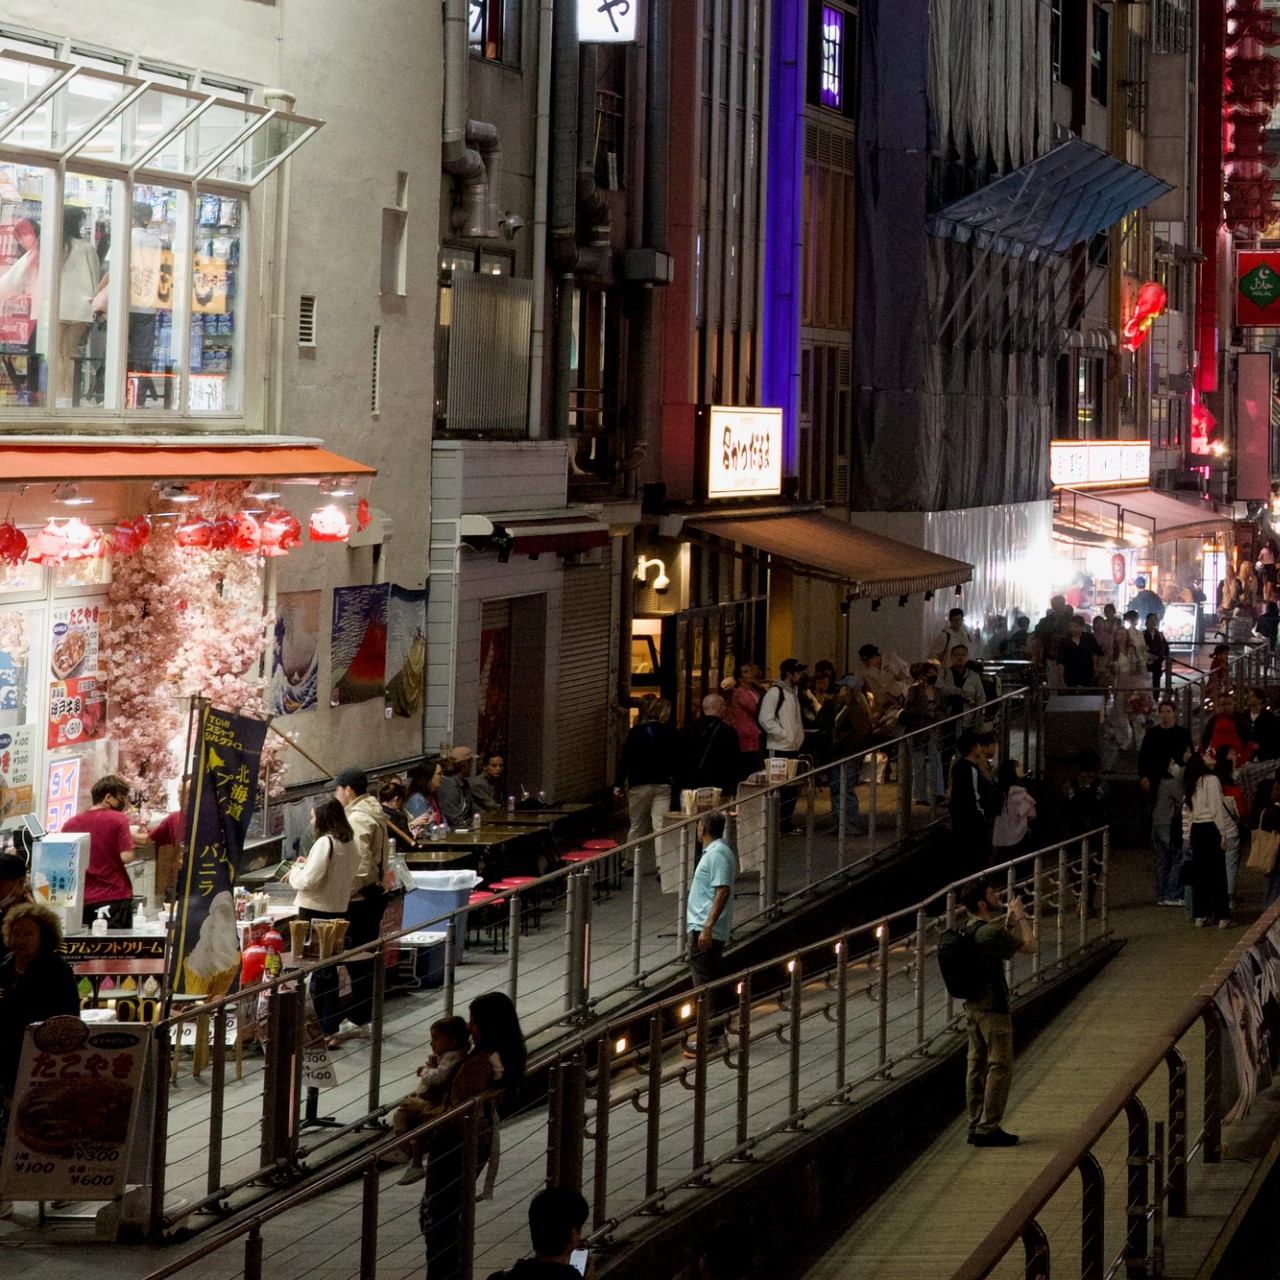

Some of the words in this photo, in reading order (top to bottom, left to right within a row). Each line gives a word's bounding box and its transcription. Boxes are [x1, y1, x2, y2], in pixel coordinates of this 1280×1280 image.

[69, 606, 100, 626] たこやき
[225, 763, 250, 821] 北海道
[198, 844, 218, 897] バニラ
[30, 1053, 135, 1079] たこやき
[15, 1161, 55, 1174] ¥100
[71, 1174, 114, 1186] ¥600
